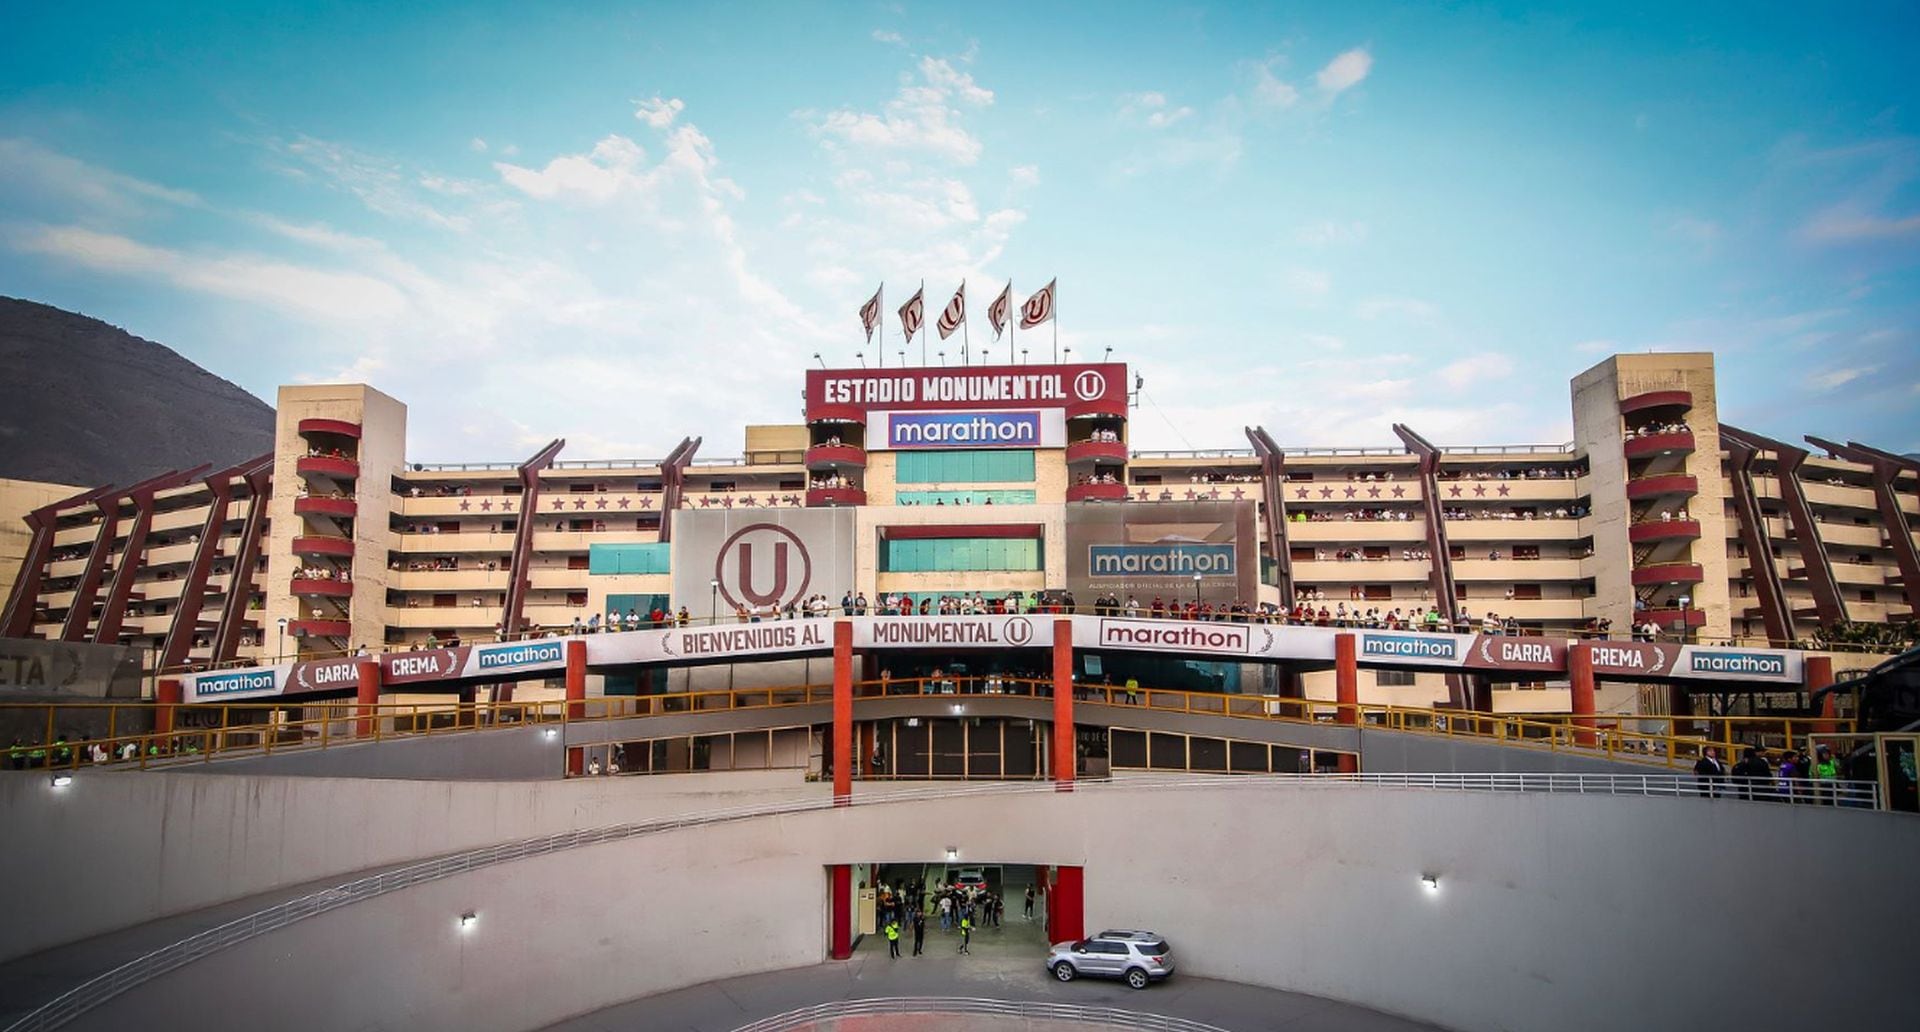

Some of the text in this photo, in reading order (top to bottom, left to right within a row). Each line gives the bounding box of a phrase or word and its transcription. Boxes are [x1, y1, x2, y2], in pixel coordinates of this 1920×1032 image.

[825, 377, 915, 403] ESTADIO
[923, 374, 1067, 401] MONUMENTAL
[895, 417, 1034, 441] marathon
[1094, 548, 1230, 575] marathon
[682, 627, 796, 655] BIENVENIDOS
[801, 624, 825, 646] AL
[872, 622, 998, 643] MONUMENTAL
[1106, 624, 1242, 649] marathon
[199, 644, 560, 693] marathon GARRA CREMA marathon
[1366, 638, 1782, 673] marathon GARRA CREMA marathon
